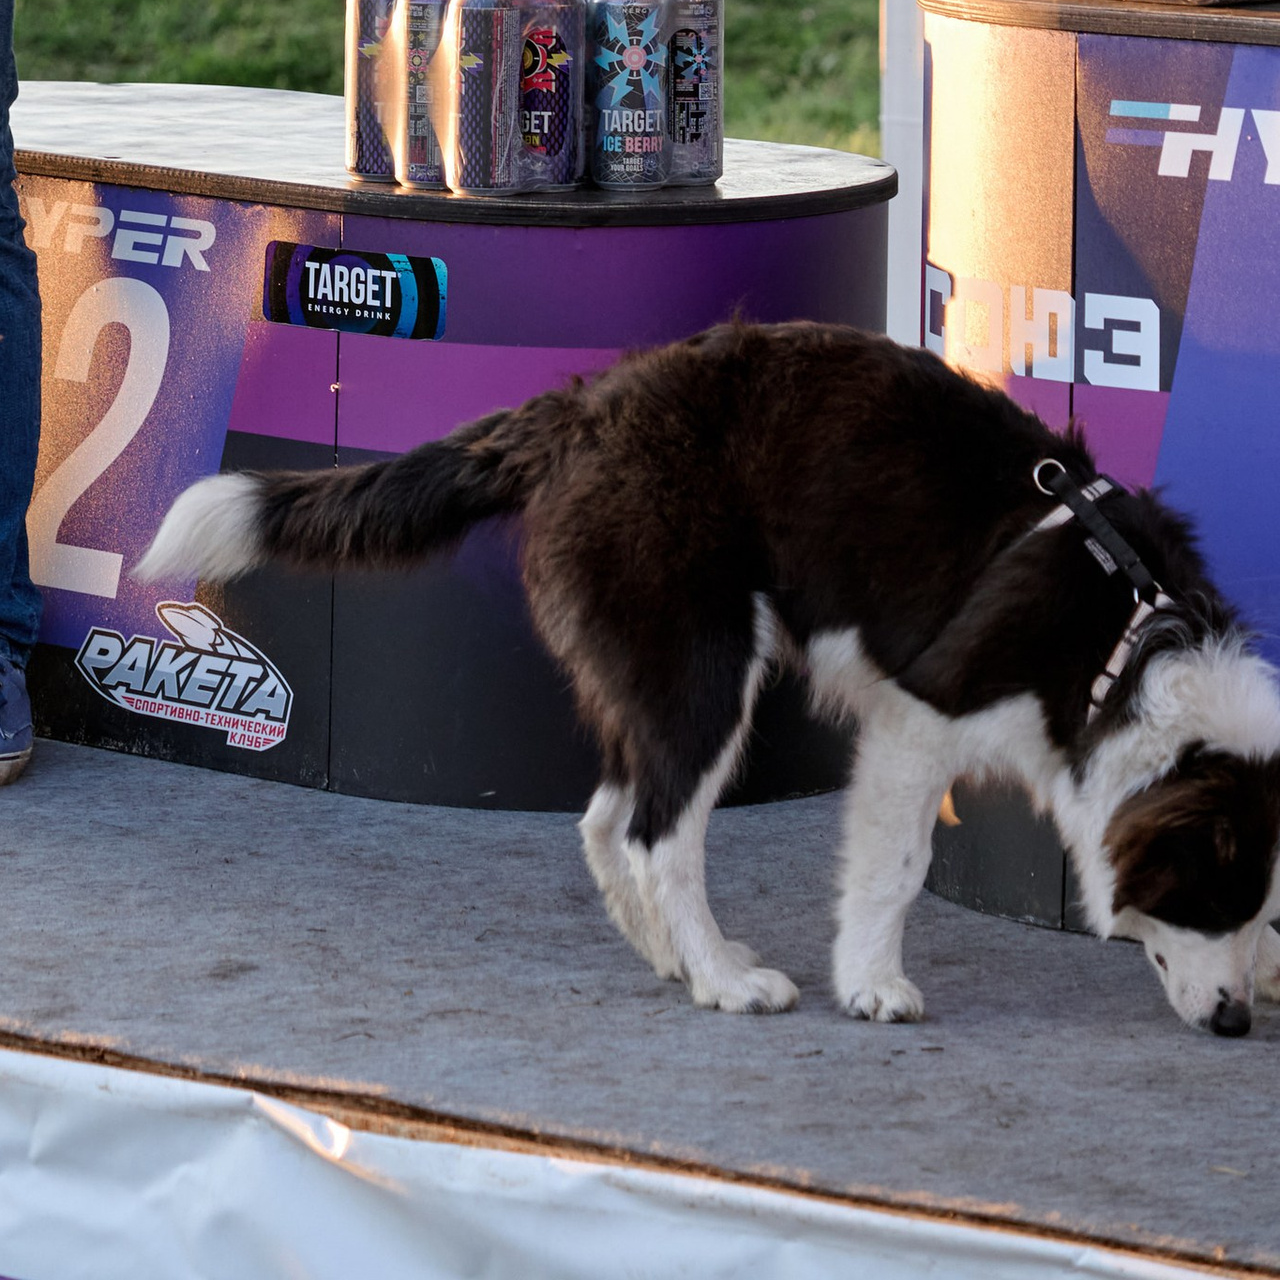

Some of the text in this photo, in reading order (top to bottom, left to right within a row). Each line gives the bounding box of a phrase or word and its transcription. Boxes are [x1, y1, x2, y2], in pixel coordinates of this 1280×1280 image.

[522, 111, 552, 134] GET
[602, 109, 662, 133] TARGET
[603, 135, 663, 153] ICE BERRY
[26, 196, 217, 272] YPER
[305, 261, 397, 308] TARGET
[308, 303, 391, 321] ENERGY DRINK
[29, 277, 170, 599] 2
[81, 633, 288, 719] РАКЕТА
[134, 698, 285, 738] СПОРТИВНО-ТЕХНИЧЕСКИЙ
[229, 732, 262, 748] КЛУБ
